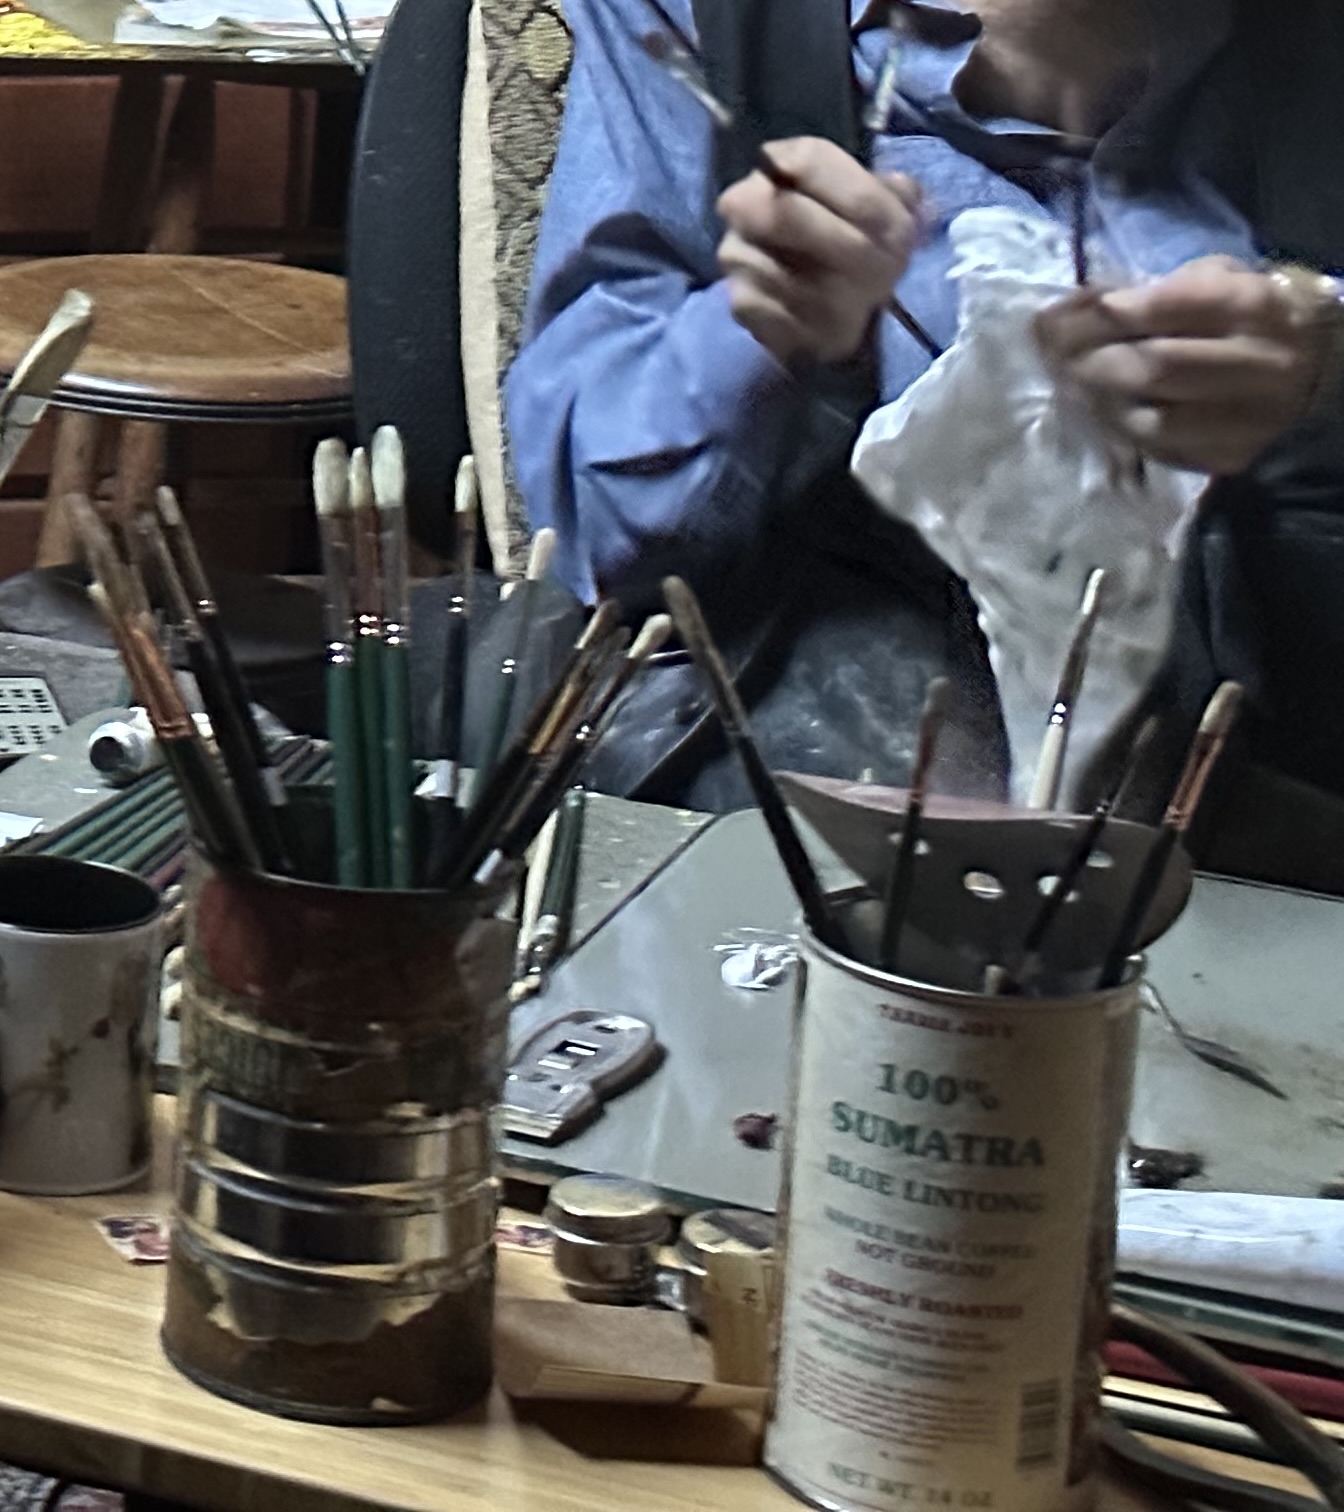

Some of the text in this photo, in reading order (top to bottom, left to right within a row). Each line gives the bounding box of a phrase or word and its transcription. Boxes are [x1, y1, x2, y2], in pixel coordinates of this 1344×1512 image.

[876, 1063, 999, 1111] 100%
[832, 1101, 1045, 1168] SUMATRA
[826, 1154, 1044, 1213] BLUE LINTONG
[855, 1238, 898, 1263] NOT
